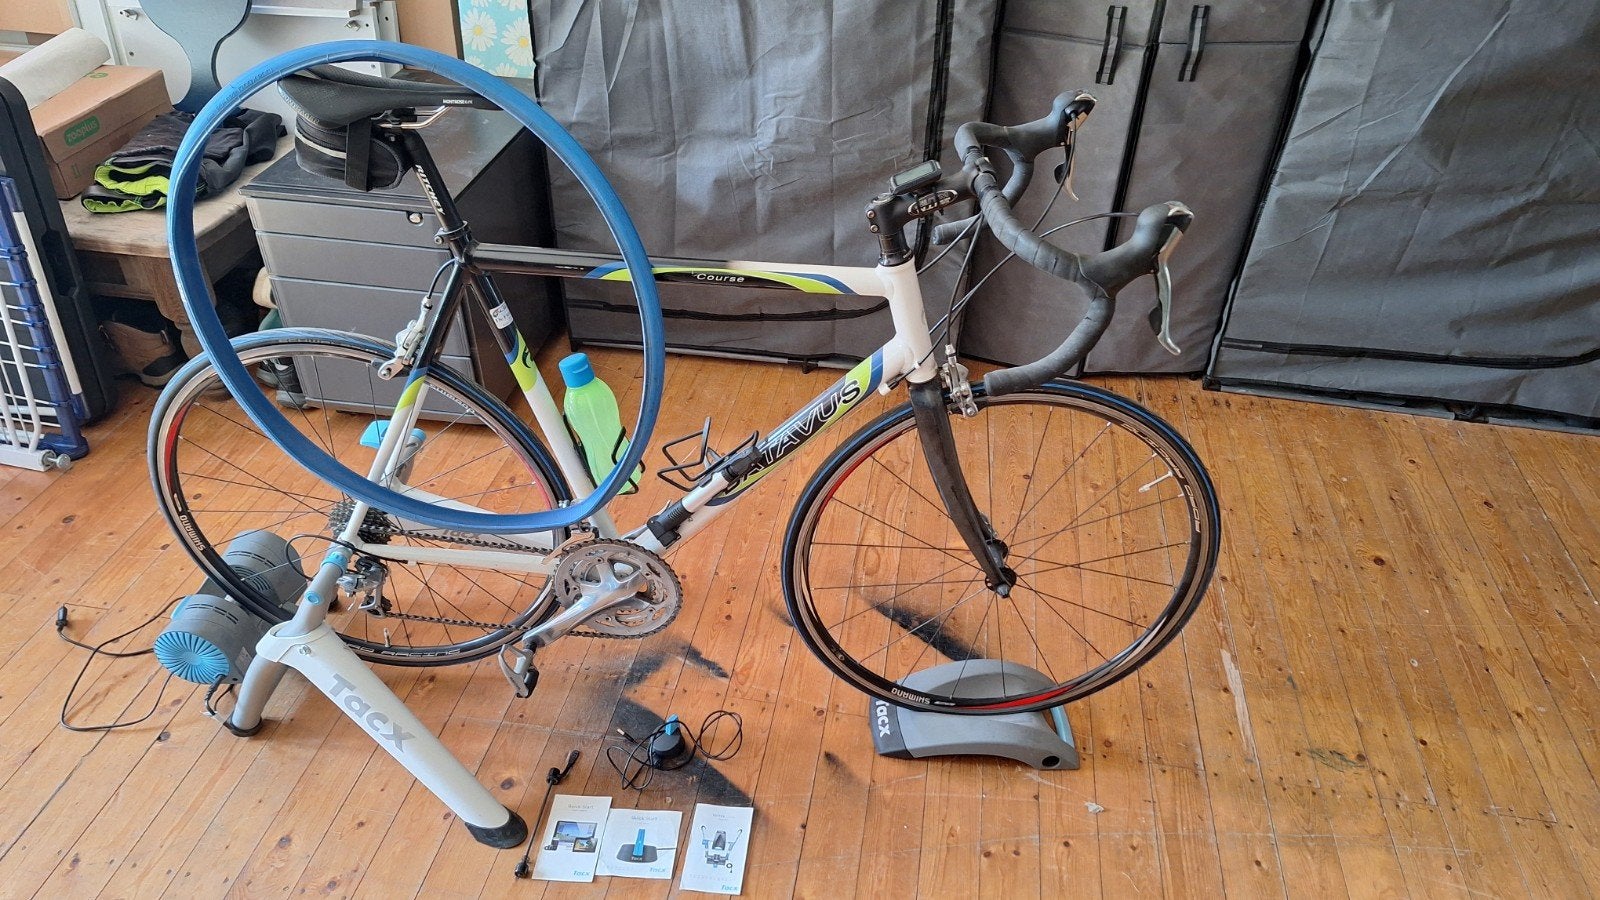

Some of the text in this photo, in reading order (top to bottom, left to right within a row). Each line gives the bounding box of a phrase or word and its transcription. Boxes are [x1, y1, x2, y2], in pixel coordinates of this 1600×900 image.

[415, 164, 446, 215] RITCHEY
[696, 273, 745, 283] Course
[180, 514, 207, 551] SHIMANO
[328, 672, 416, 753] Tacx
[891, 687, 931, 705] SHIMANO
